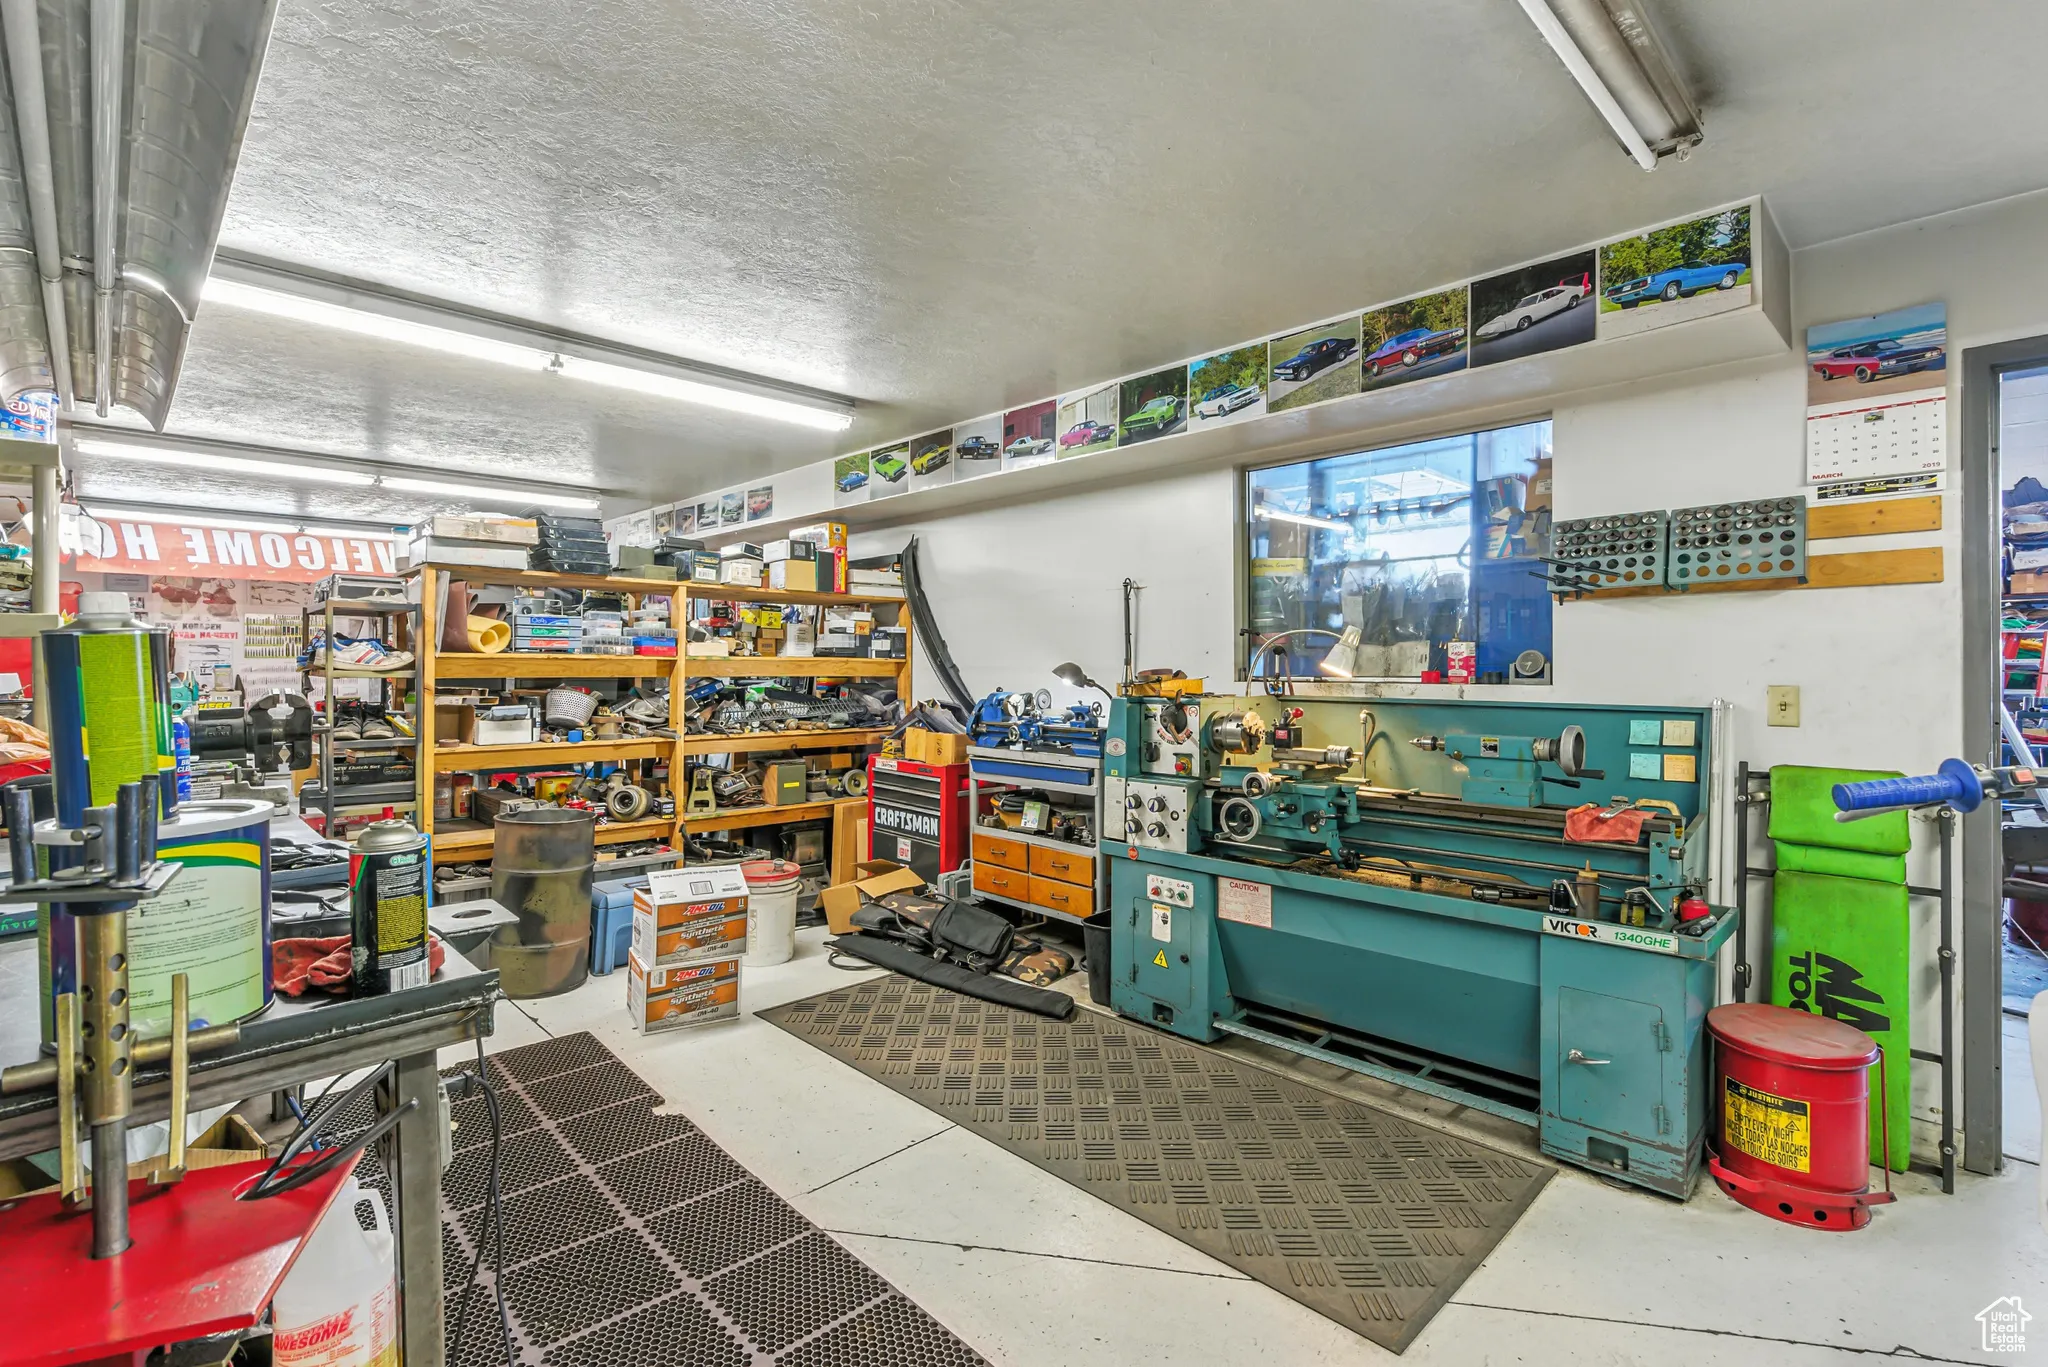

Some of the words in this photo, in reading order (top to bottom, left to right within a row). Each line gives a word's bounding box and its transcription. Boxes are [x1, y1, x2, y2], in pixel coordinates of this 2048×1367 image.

[1812, 472, 1843, 480] MARCH
[874, 806, 938, 836] CRAFTSMAN
[1229, 882, 1259, 892] CAUTION
[682, 902, 726, 916] AMSOIL
[680, 924, 726, 939] Synthetic
[1549, 920, 1598, 938] VICTOR
[707, 943, 728, 952] 0W-40
[1614, 932, 1672, 948] 1340GHE
[672, 966, 716, 982] AMSOIL
[670, 989, 715, 1005] Synthetic
[697, 1007, 719, 1016] 0W-40
[1748, 1090, 1783, 1106] JUSTRITE
[1753, 1118, 1771, 1136] EVERY
[1774, 1126, 1794, 1142] NIGHT
[1745, 1128, 1765, 1146] TODAS
[1767, 1137, 1778, 1150] LAS
[1780, 1141, 1807, 1157] NOCHES
[1747, 1141, 1762, 1157] TOUS
[1764, 1148, 1775, 1161] LES
[1778, 1151, 1798, 1168] SOIRS
[274, 1317, 353, 1351] AWESOME
